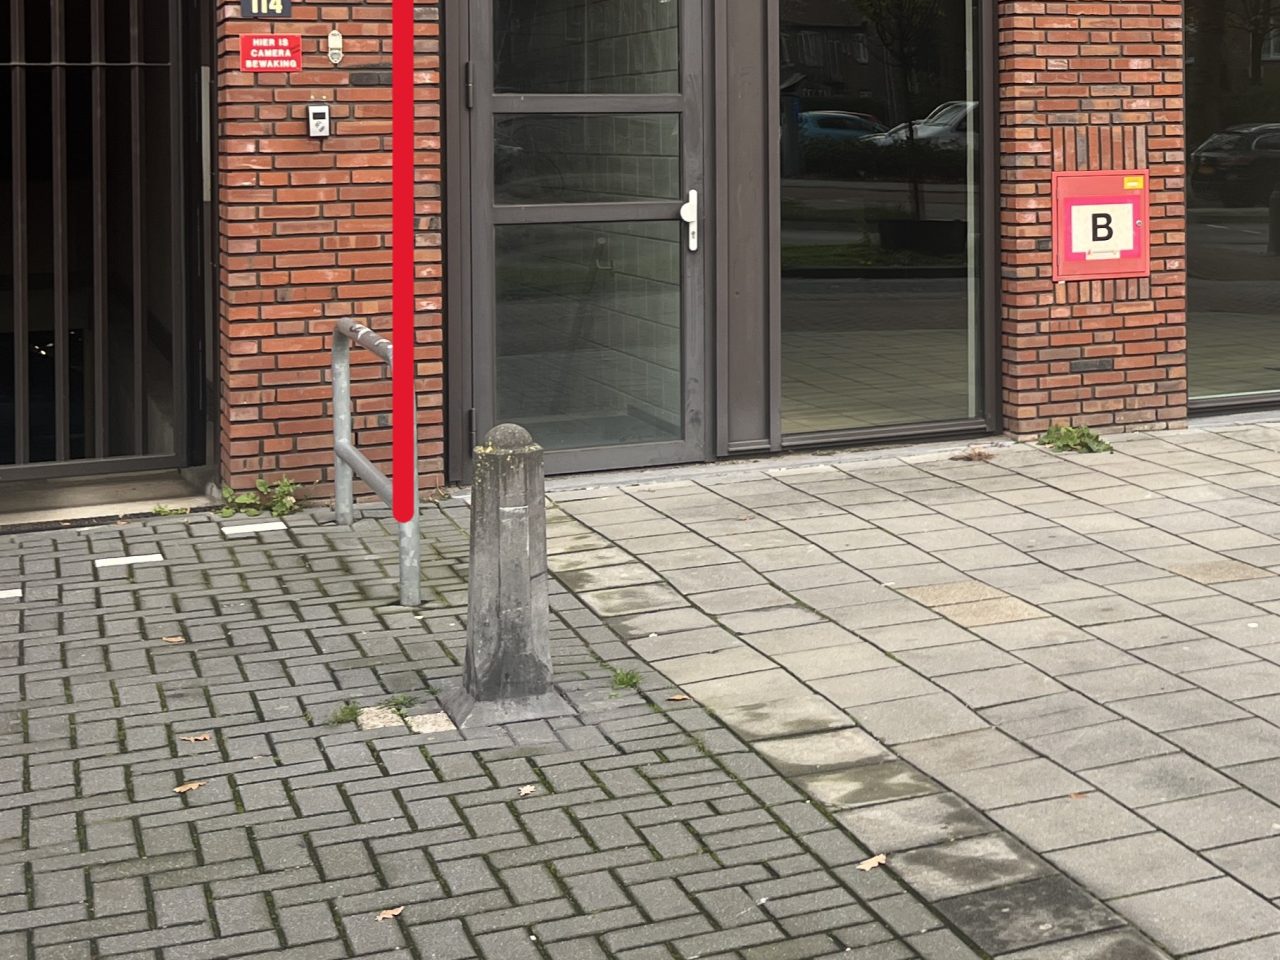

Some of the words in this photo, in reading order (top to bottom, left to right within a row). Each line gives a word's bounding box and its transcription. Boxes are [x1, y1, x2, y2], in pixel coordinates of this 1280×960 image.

[252, 38, 277, 48] HIER
[278, 38, 289, 48] IS
[250, 48, 292, 58] CAMERA
[245, 59, 297, 69] BEWAKING
[1091, 212, 1114, 242] B
